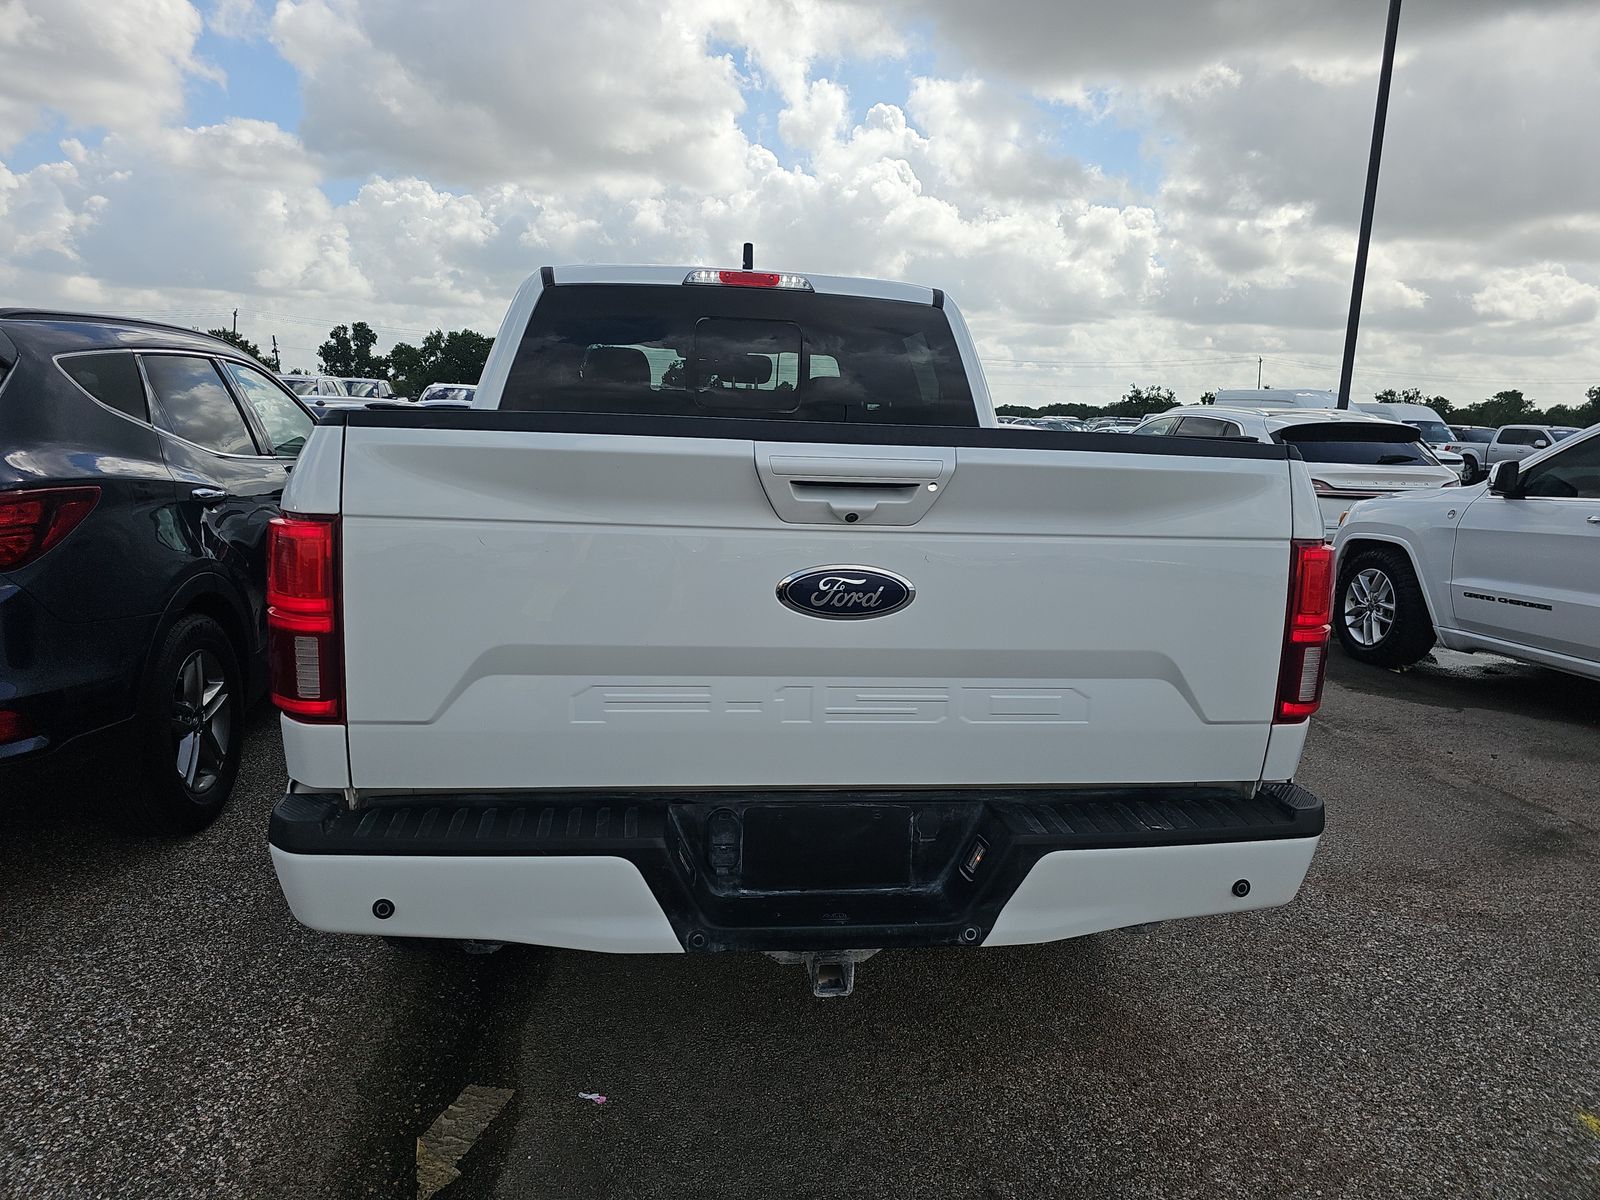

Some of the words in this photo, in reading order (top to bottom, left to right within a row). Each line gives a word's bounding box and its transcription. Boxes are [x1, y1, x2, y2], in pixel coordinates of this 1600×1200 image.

[810, 576, 885, 607] Ford
[1463, 592, 1495, 602] GRAND
[570, 684, 1092, 724] F-150
